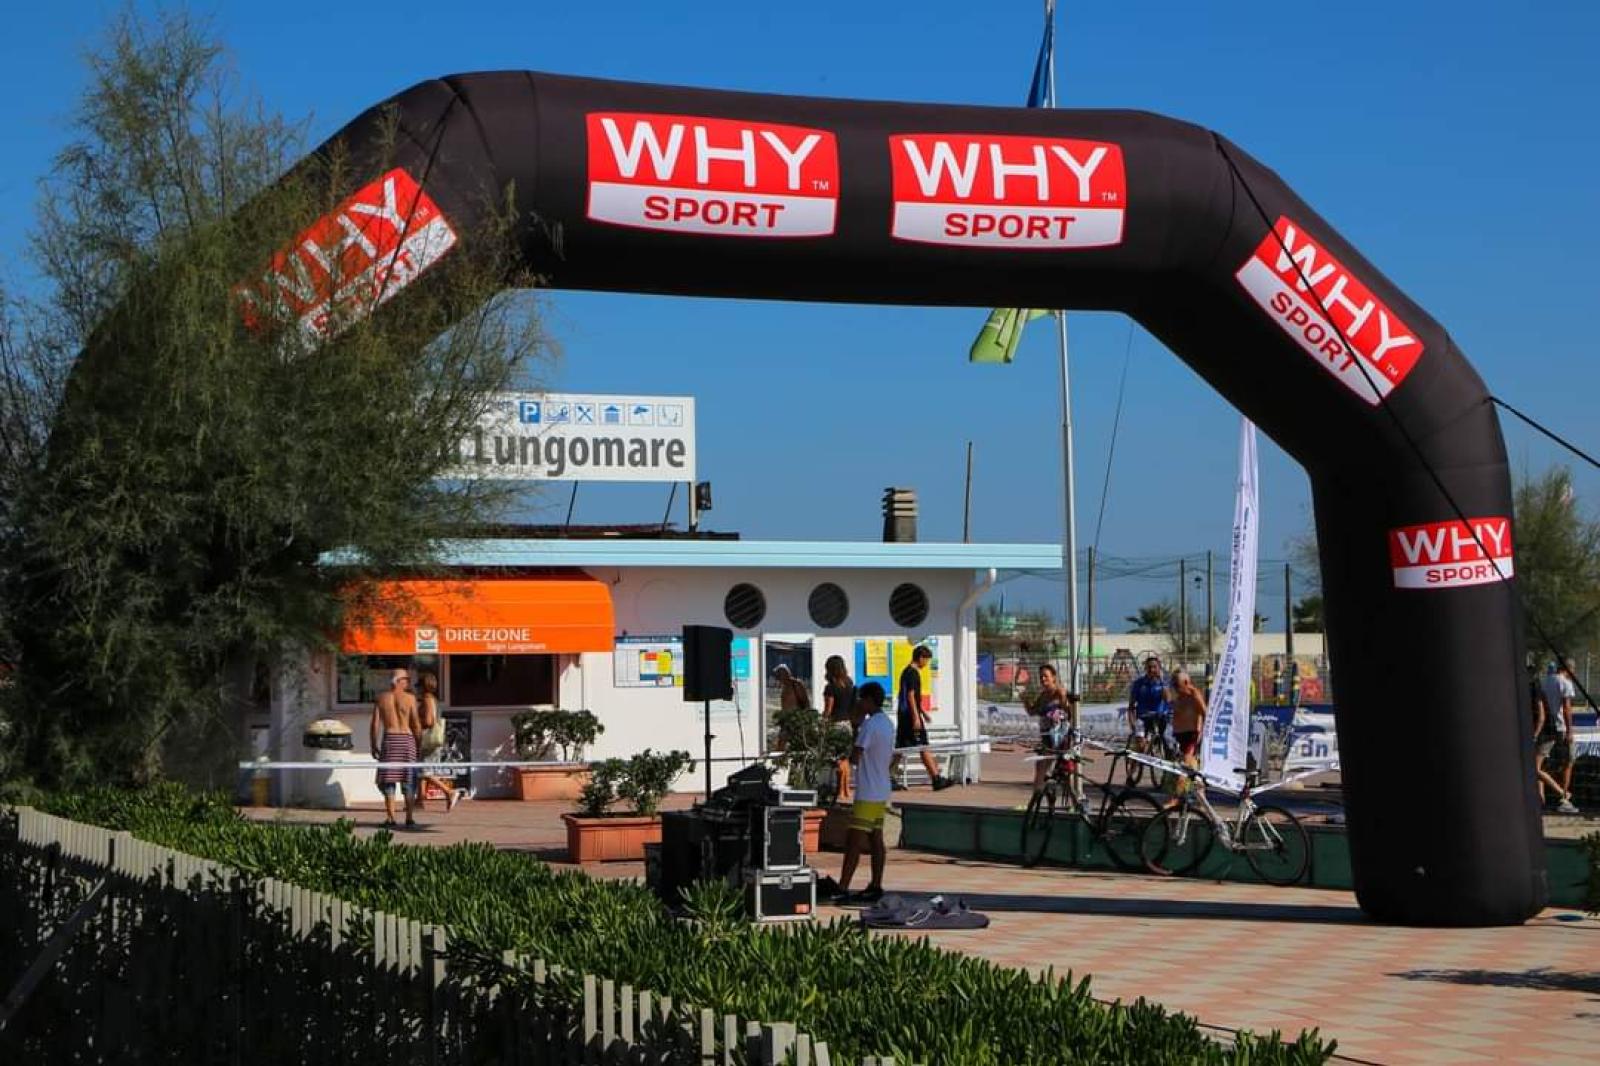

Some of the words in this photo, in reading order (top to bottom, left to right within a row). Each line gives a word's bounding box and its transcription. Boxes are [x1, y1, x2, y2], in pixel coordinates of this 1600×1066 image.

[601, 118, 822, 190] WHY
[903, 139, 1108, 202] WHY
[643, 196, 785, 228] SPORT
[944, 213, 1076, 240] SPORT
[1276, 225, 1416, 362] WHY
[1270, 291, 1355, 372] SPORT
[475, 425, 686, 476] Lungomare
[1398, 521, 1506, 564] WHY
[1426, 564, 1496, 582] SPORT
[445, 628, 531, 640] DIREZIONE
